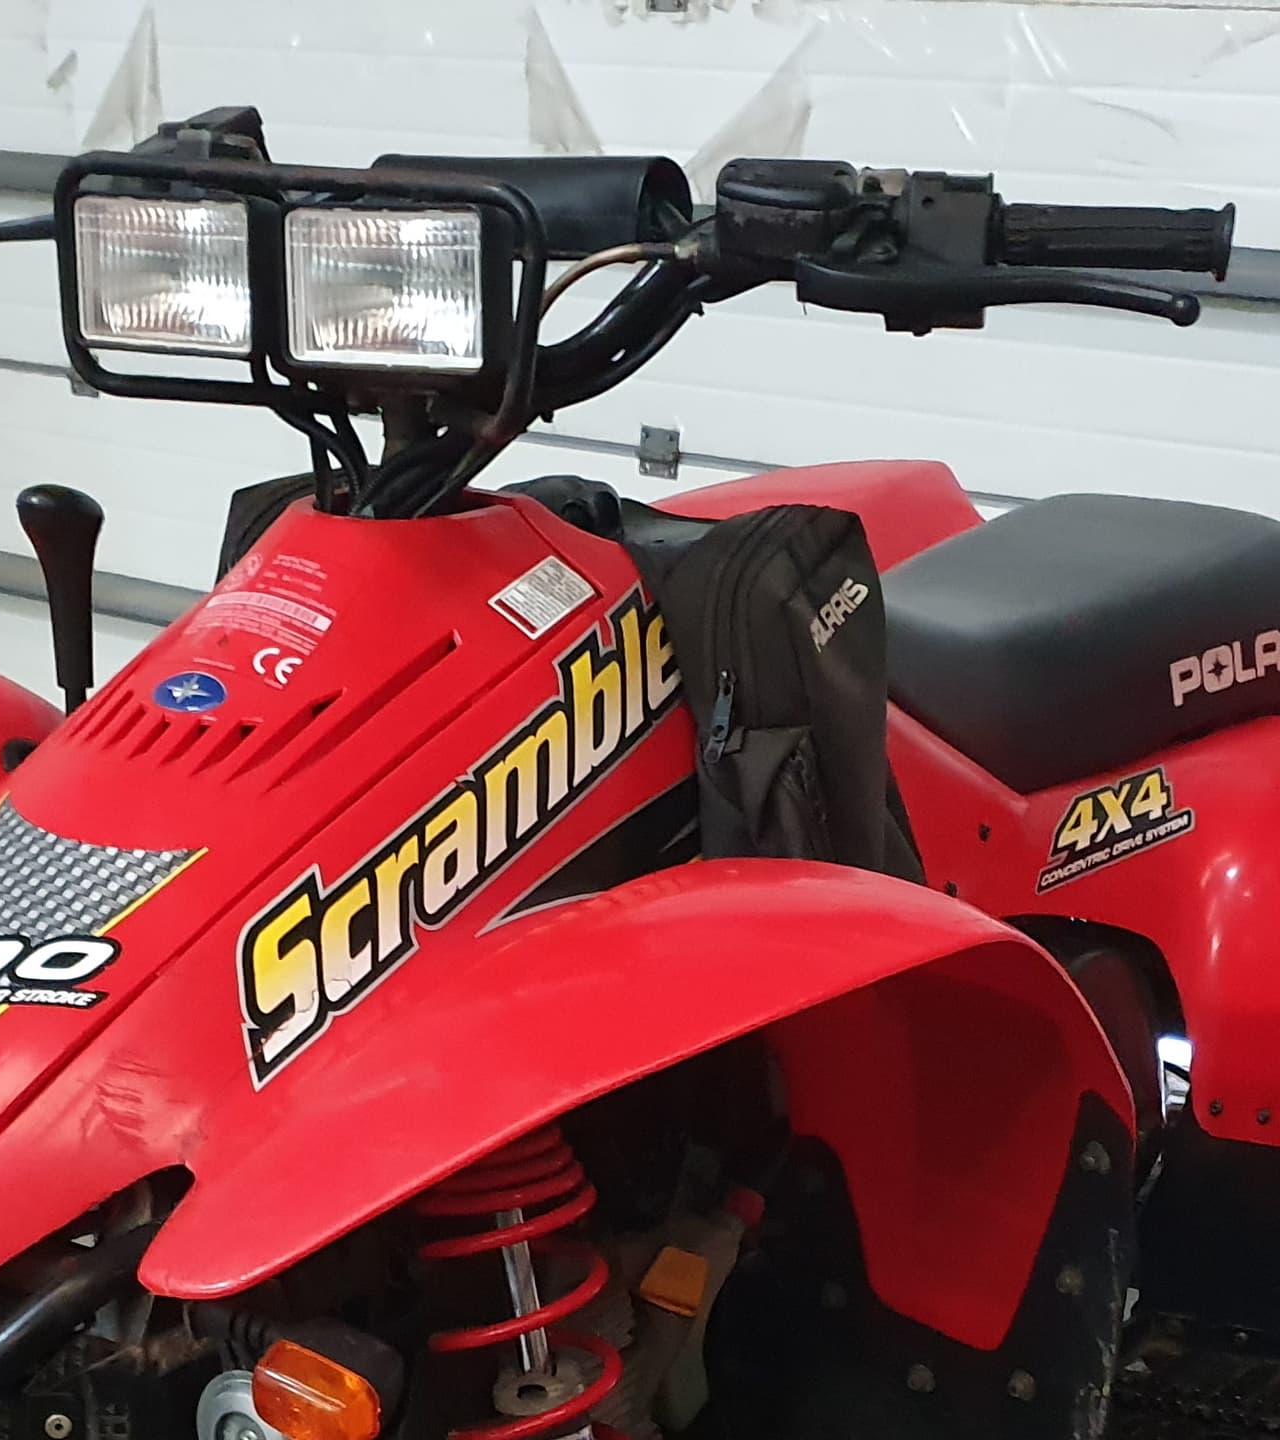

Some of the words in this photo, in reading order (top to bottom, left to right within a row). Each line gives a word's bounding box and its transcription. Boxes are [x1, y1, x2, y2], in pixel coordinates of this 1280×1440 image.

[1040, 847, 1111, 887] CONCENTRIC
[1112, 834, 1144, 856] DRIVE
[1145, 814, 1189, 842] SYSTEM
[9, 989, 98, 1007] STROKE
